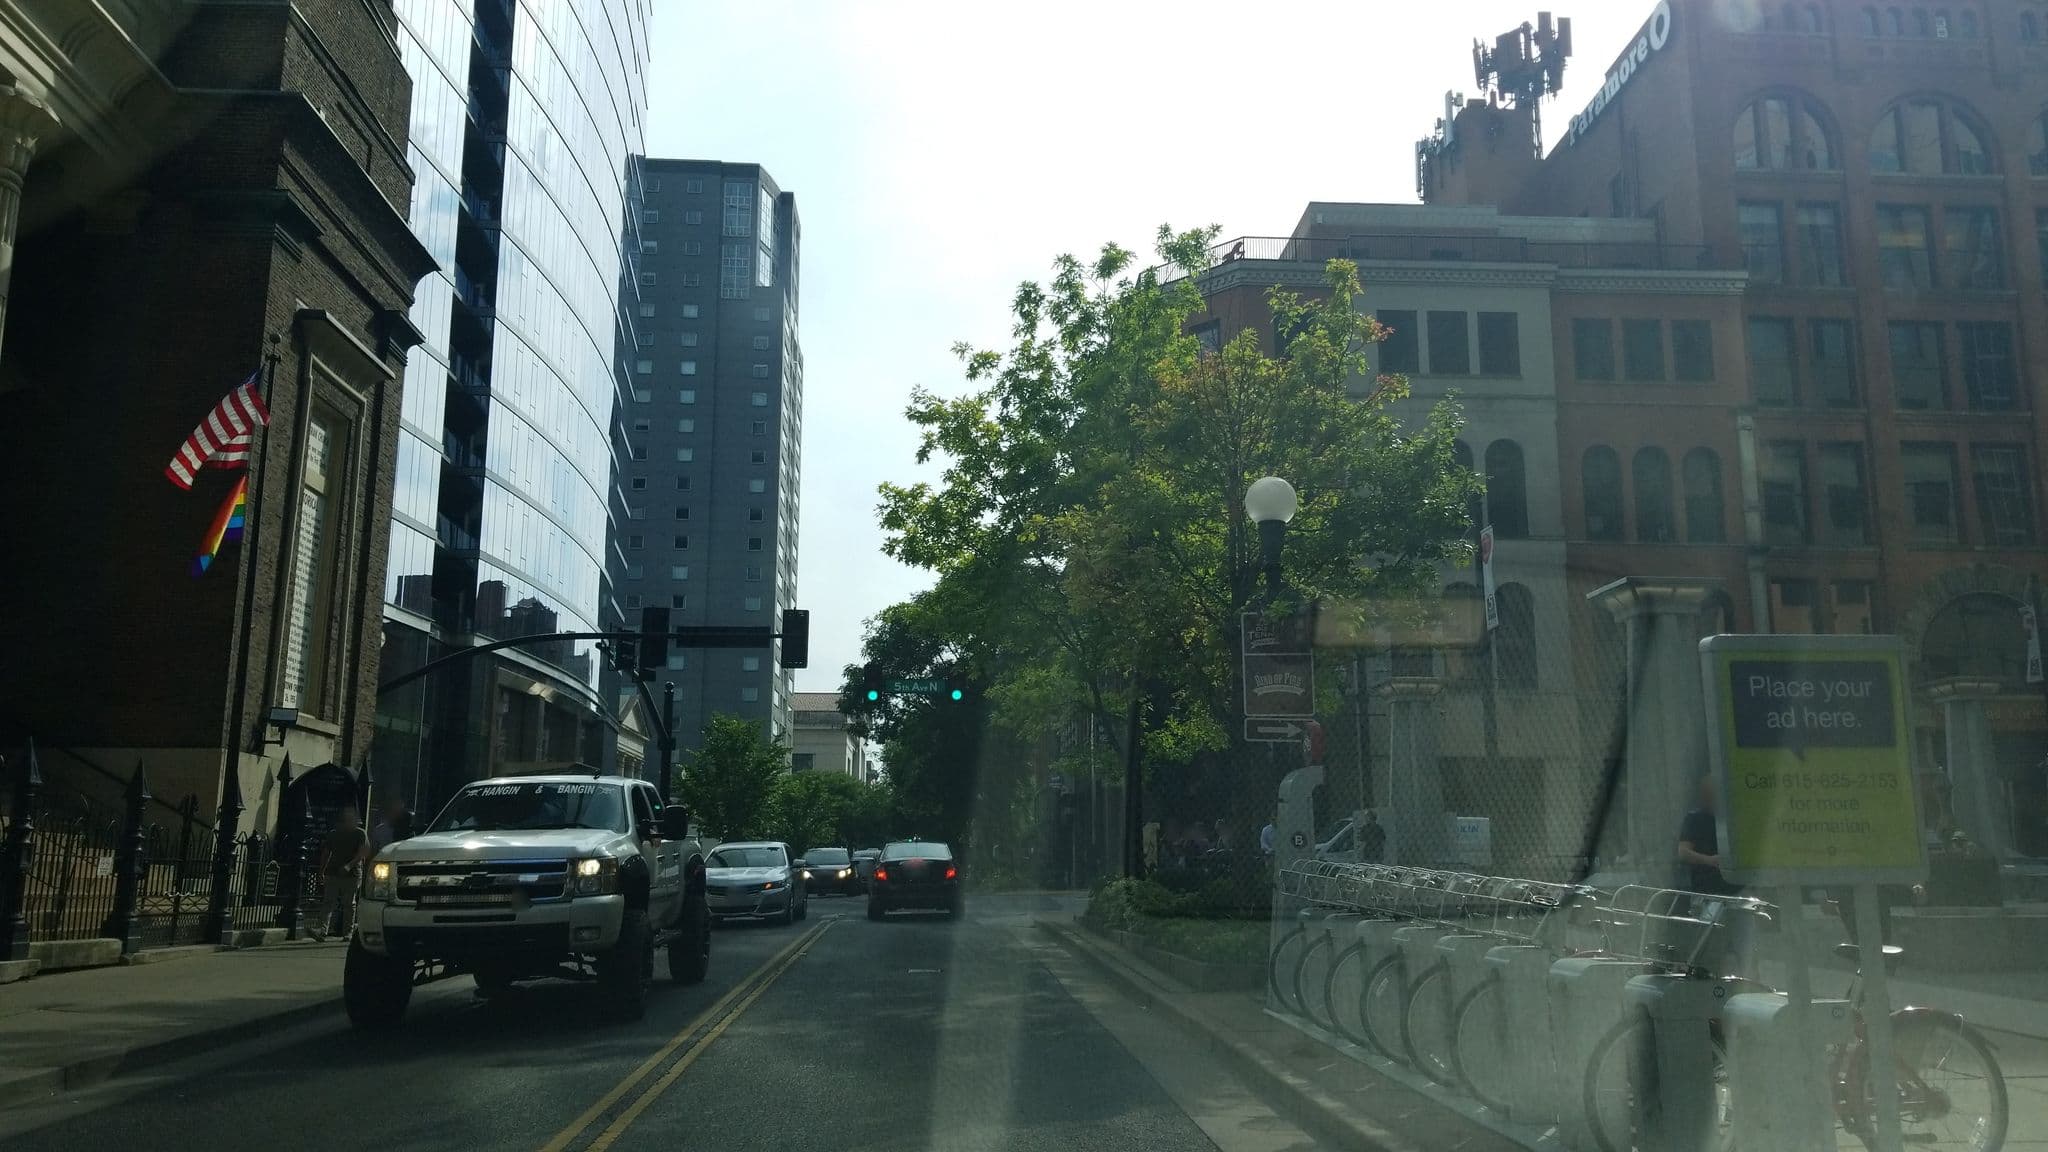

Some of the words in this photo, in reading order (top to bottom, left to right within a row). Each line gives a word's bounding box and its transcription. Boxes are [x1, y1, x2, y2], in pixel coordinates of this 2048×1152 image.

[1569, 36, 1648, 146] Paramore
[930, 682, 938, 691] N
[1749, 675, 1815, 697] Place
[1821, 680, 1872, 702] your
[1767, 706, 1795, 728] ad
[1803, 706, 1862, 728] here.
[1745, 772, 1776, 789] Call
[482, 785, 521, 796] HANGIN
[535, 785, 544, 794] &
[557, 785, 596, 795] BANGIN
[1817, 799, 1860, 811] more
